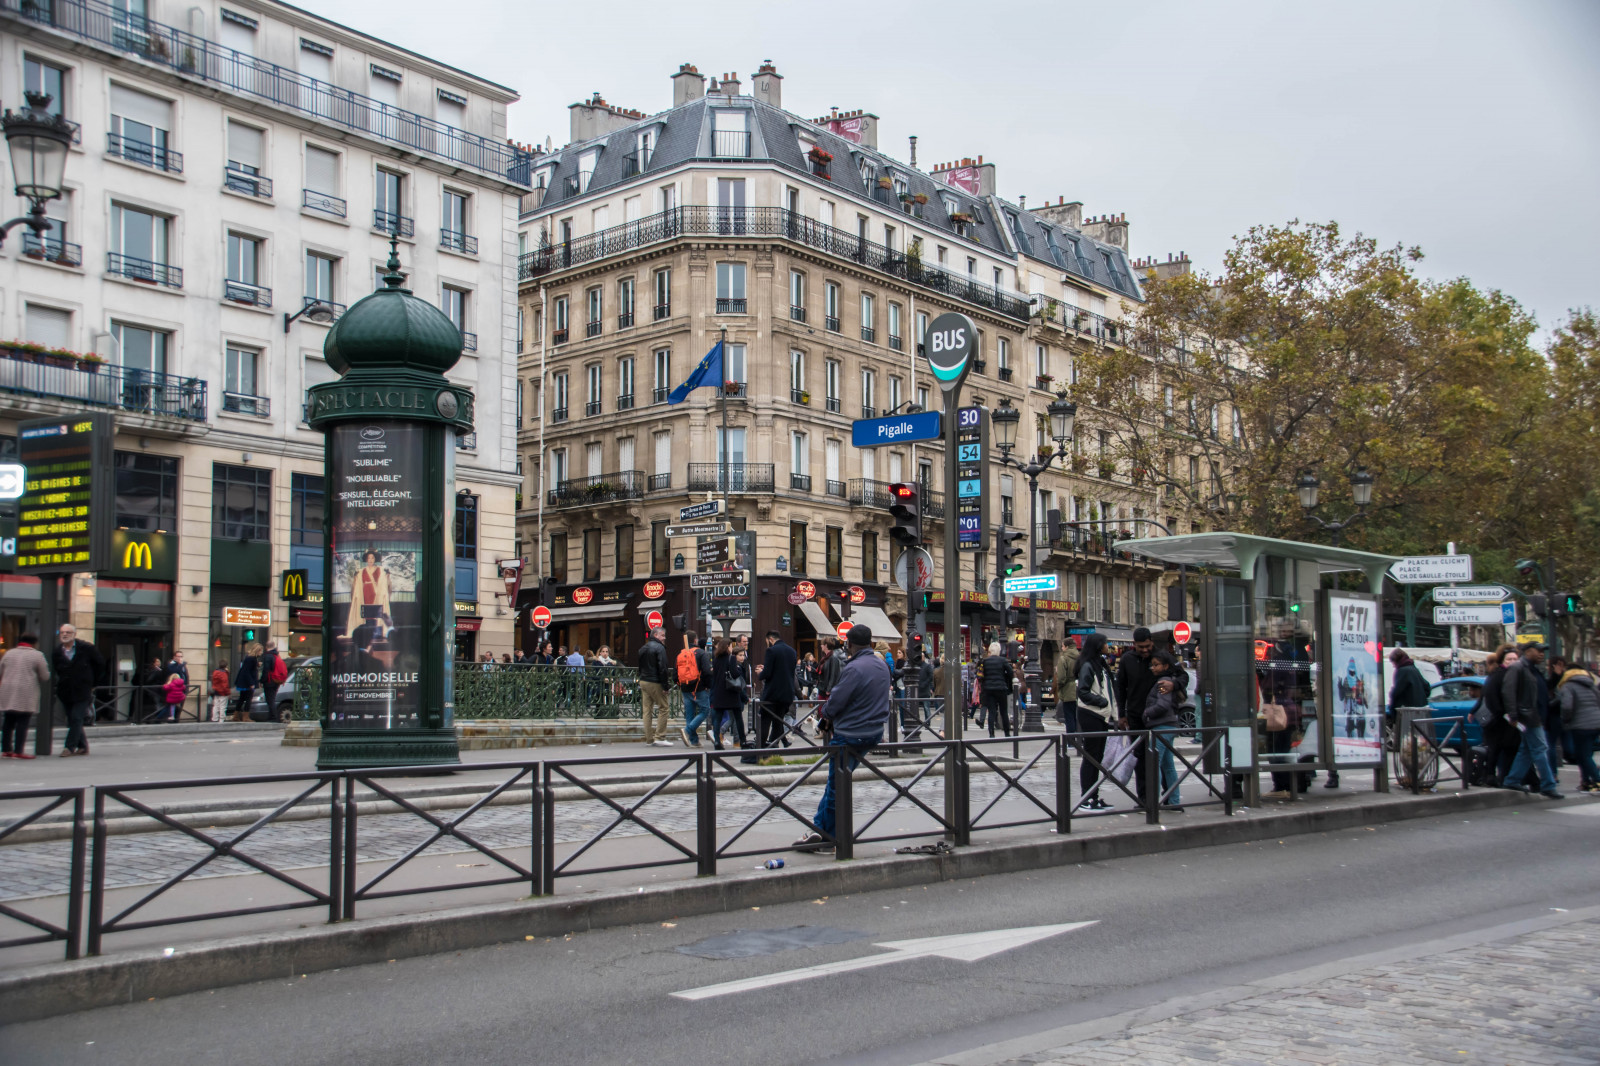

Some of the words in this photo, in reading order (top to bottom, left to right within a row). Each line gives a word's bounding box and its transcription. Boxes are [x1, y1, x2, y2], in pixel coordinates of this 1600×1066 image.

[932, 328, 965, 353] BUS
[318, 391, 426, 411] SPECTACLE
[961, 409, 978, 425] 30
[878, 422, 913, 439] Pigalle
[961, 445, 978, 460] 54
[353, 458, 392, 467] "SUBLIME"
[346, 474, 402, 483] "INOUBLIABLE"
[347, 500, 400, 508] INTELLIGENT"
[701, 586, 746, 600] JILOLO
[1052, 601, 1068, 610] PARIS
[1340, 633, 1355, 643] RACE
[1356, 634, 1368, 644] TOUR
[332, 672, 418, 684] MADEMOISELLE
